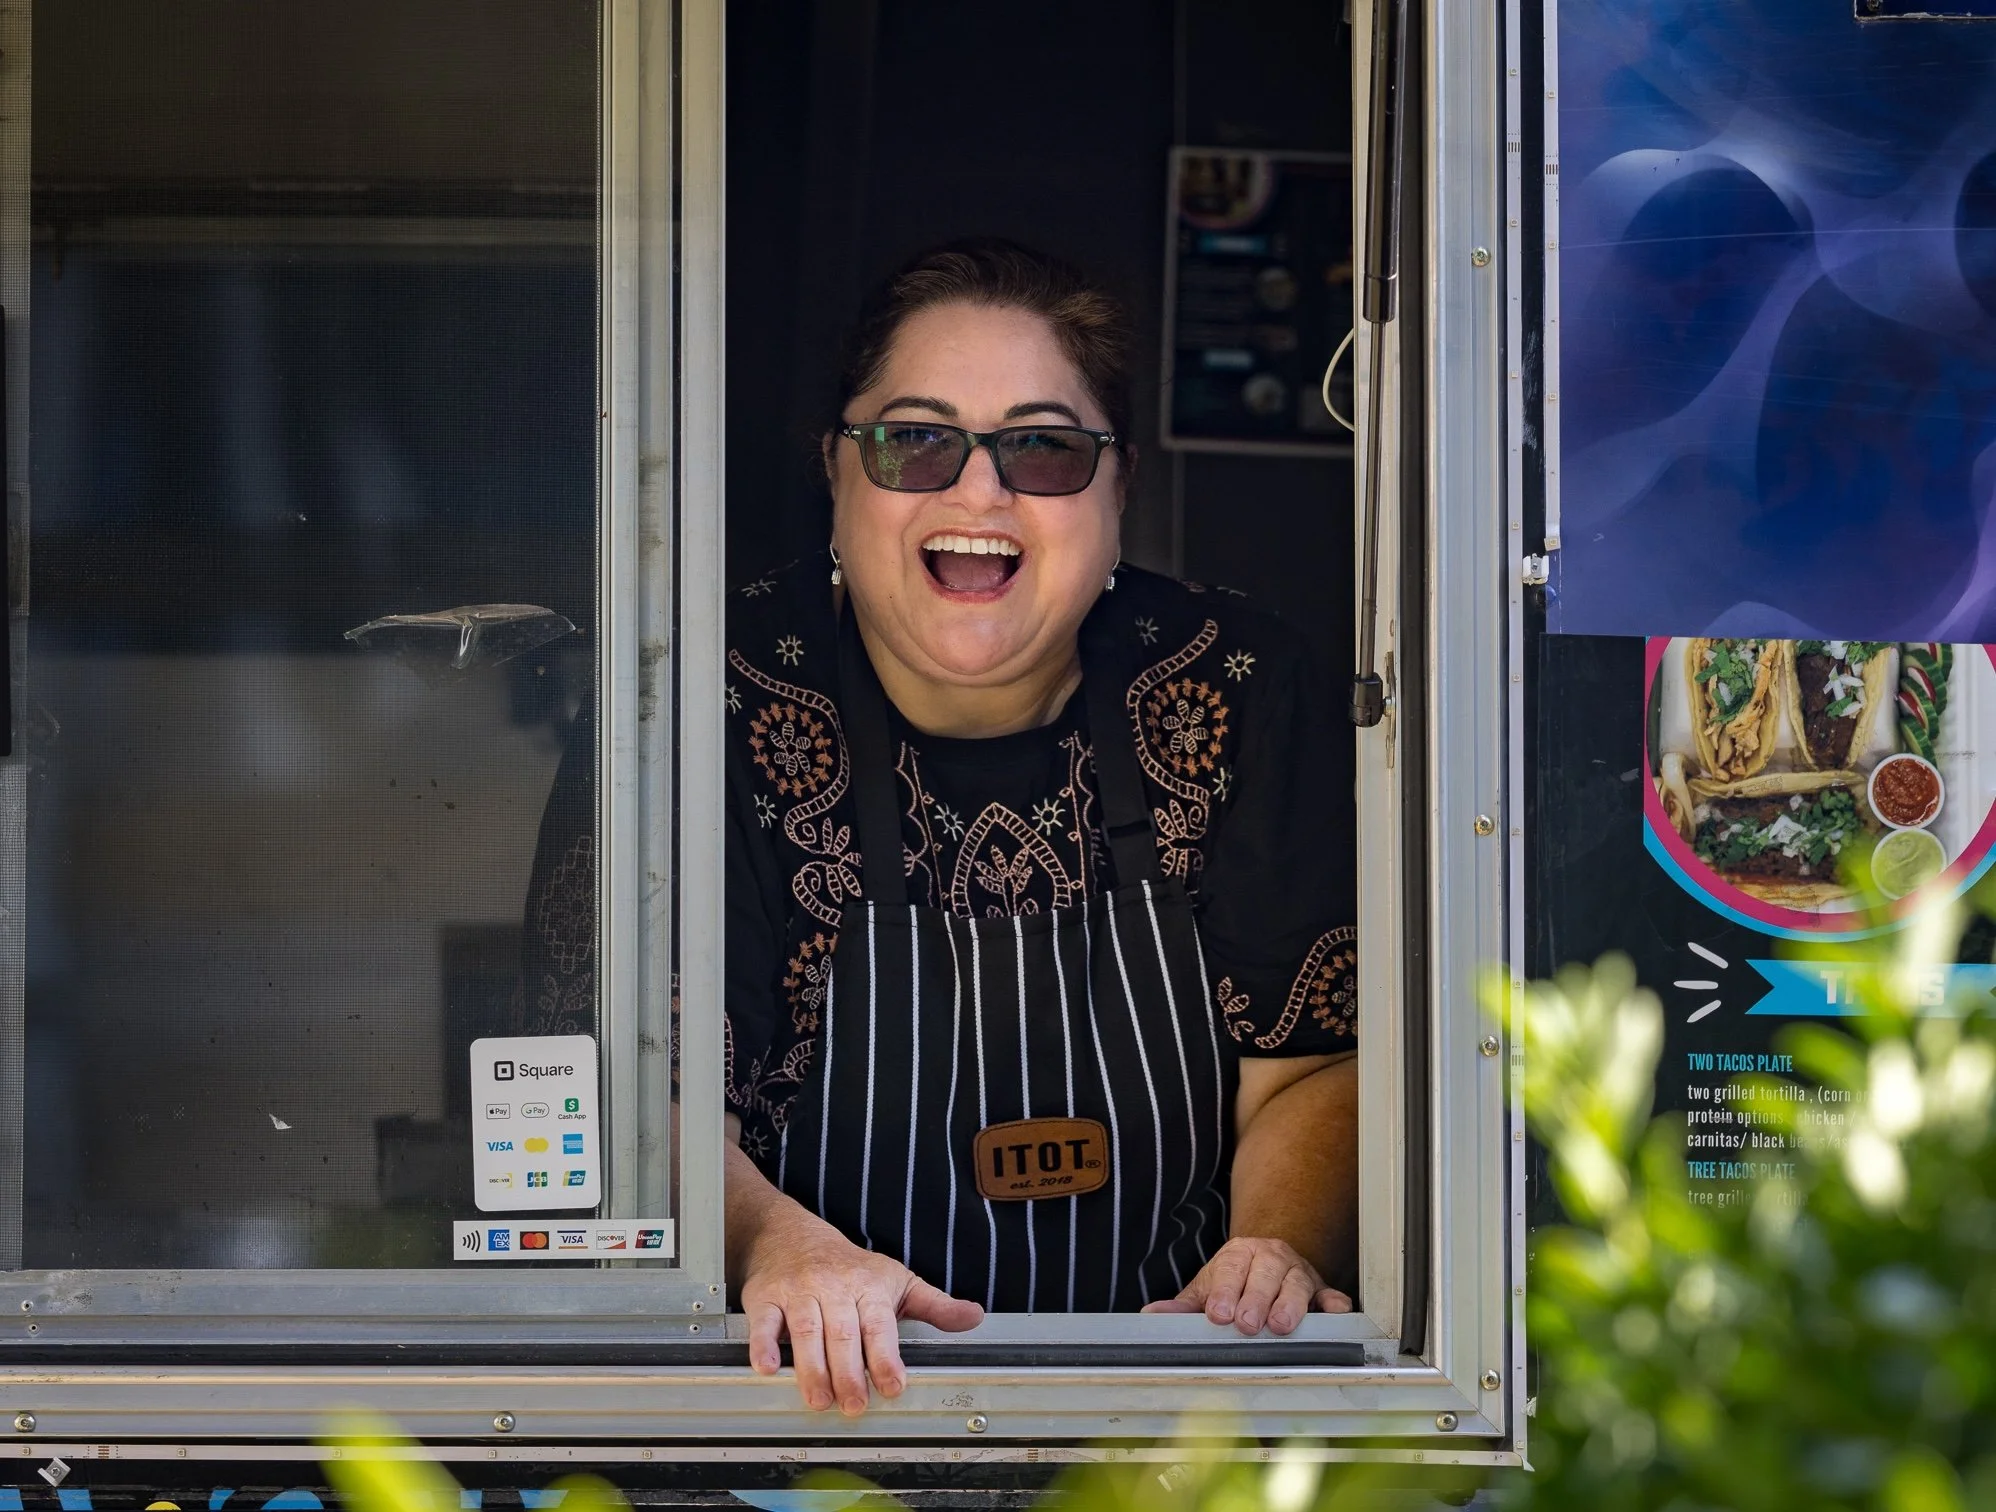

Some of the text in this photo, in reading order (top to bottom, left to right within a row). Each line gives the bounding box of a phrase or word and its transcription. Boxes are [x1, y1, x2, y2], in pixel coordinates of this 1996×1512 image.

[519, 1063, 574, 1080] Square
[1688, 1053, 1792, 1072] TWO TACOS PLATE
[1687, 1085, 1710, 1100] two
[1714, 1084, 1756, 1104] grilled
[1760, 1086, 1805, 1102] tortilla
[495, 1107, 508, 1115] Pay
[533, 1107, 545, 1115] Pay
[1687, 1109, 1733, 1127] protein
[486, 1141, 514, 1152] VISA
[1687, 1131, 1747, 1149] carnitas/
[1752, 1132, 1785, 1149] black
[992, 1139, 1090, 1178] ITOT
[1688, 1161, 1796, 1180] TREE TACOS PLATE
[1010, 1175, 1073, 1190] est. 2018
[1688, 1189, 1713, 1206] tree
[1718, 1189, 1754, 1209] grill
[561, 1235, 584, 1244] VISA
